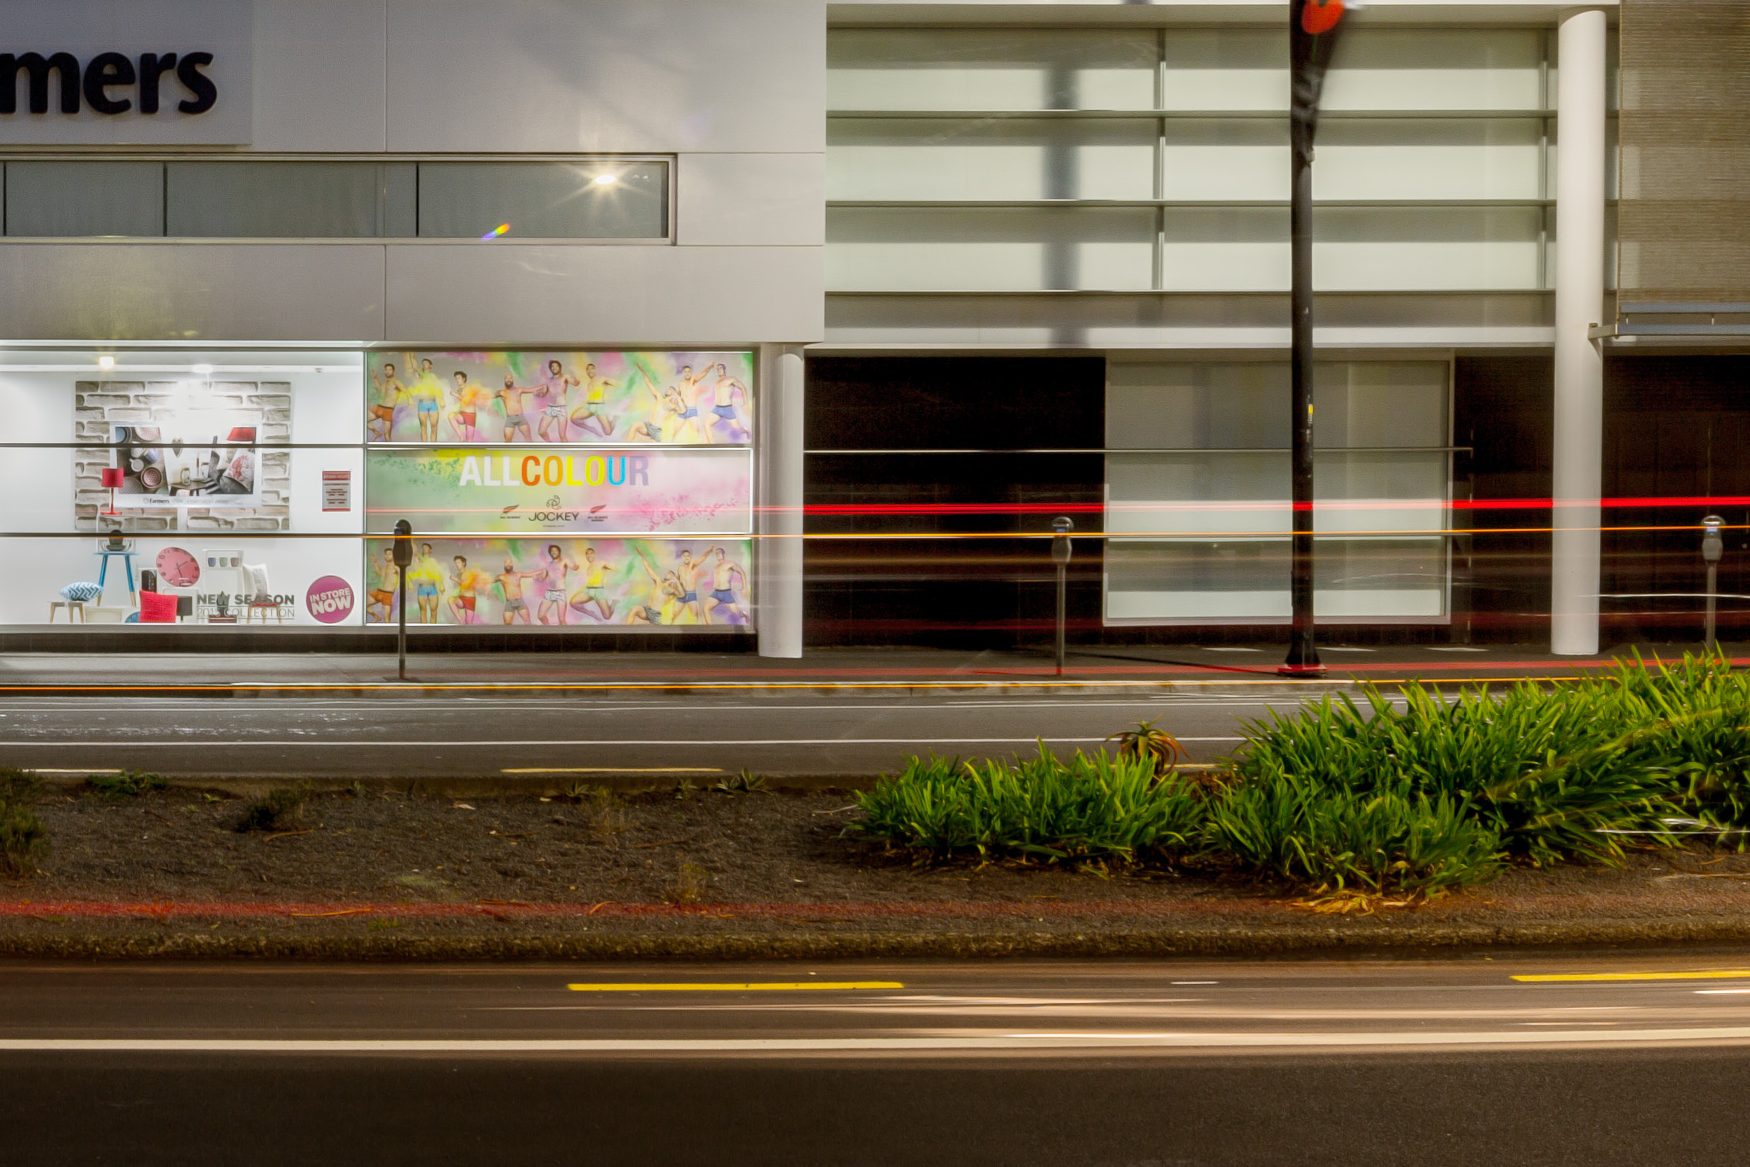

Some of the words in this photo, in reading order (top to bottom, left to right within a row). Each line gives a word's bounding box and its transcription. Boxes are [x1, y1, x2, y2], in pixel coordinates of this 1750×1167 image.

[528, 512, 579, 521] JOCKEY
[197, 594, 230, 605] NEW
[234, 594, 295, 605] SEASON
[310, 594, 320, 603] IN
[320, 588, 351, 601] STORE
[311, 595, 351, 616] NOW
[224, 608, 295, 618] COLLECTION
